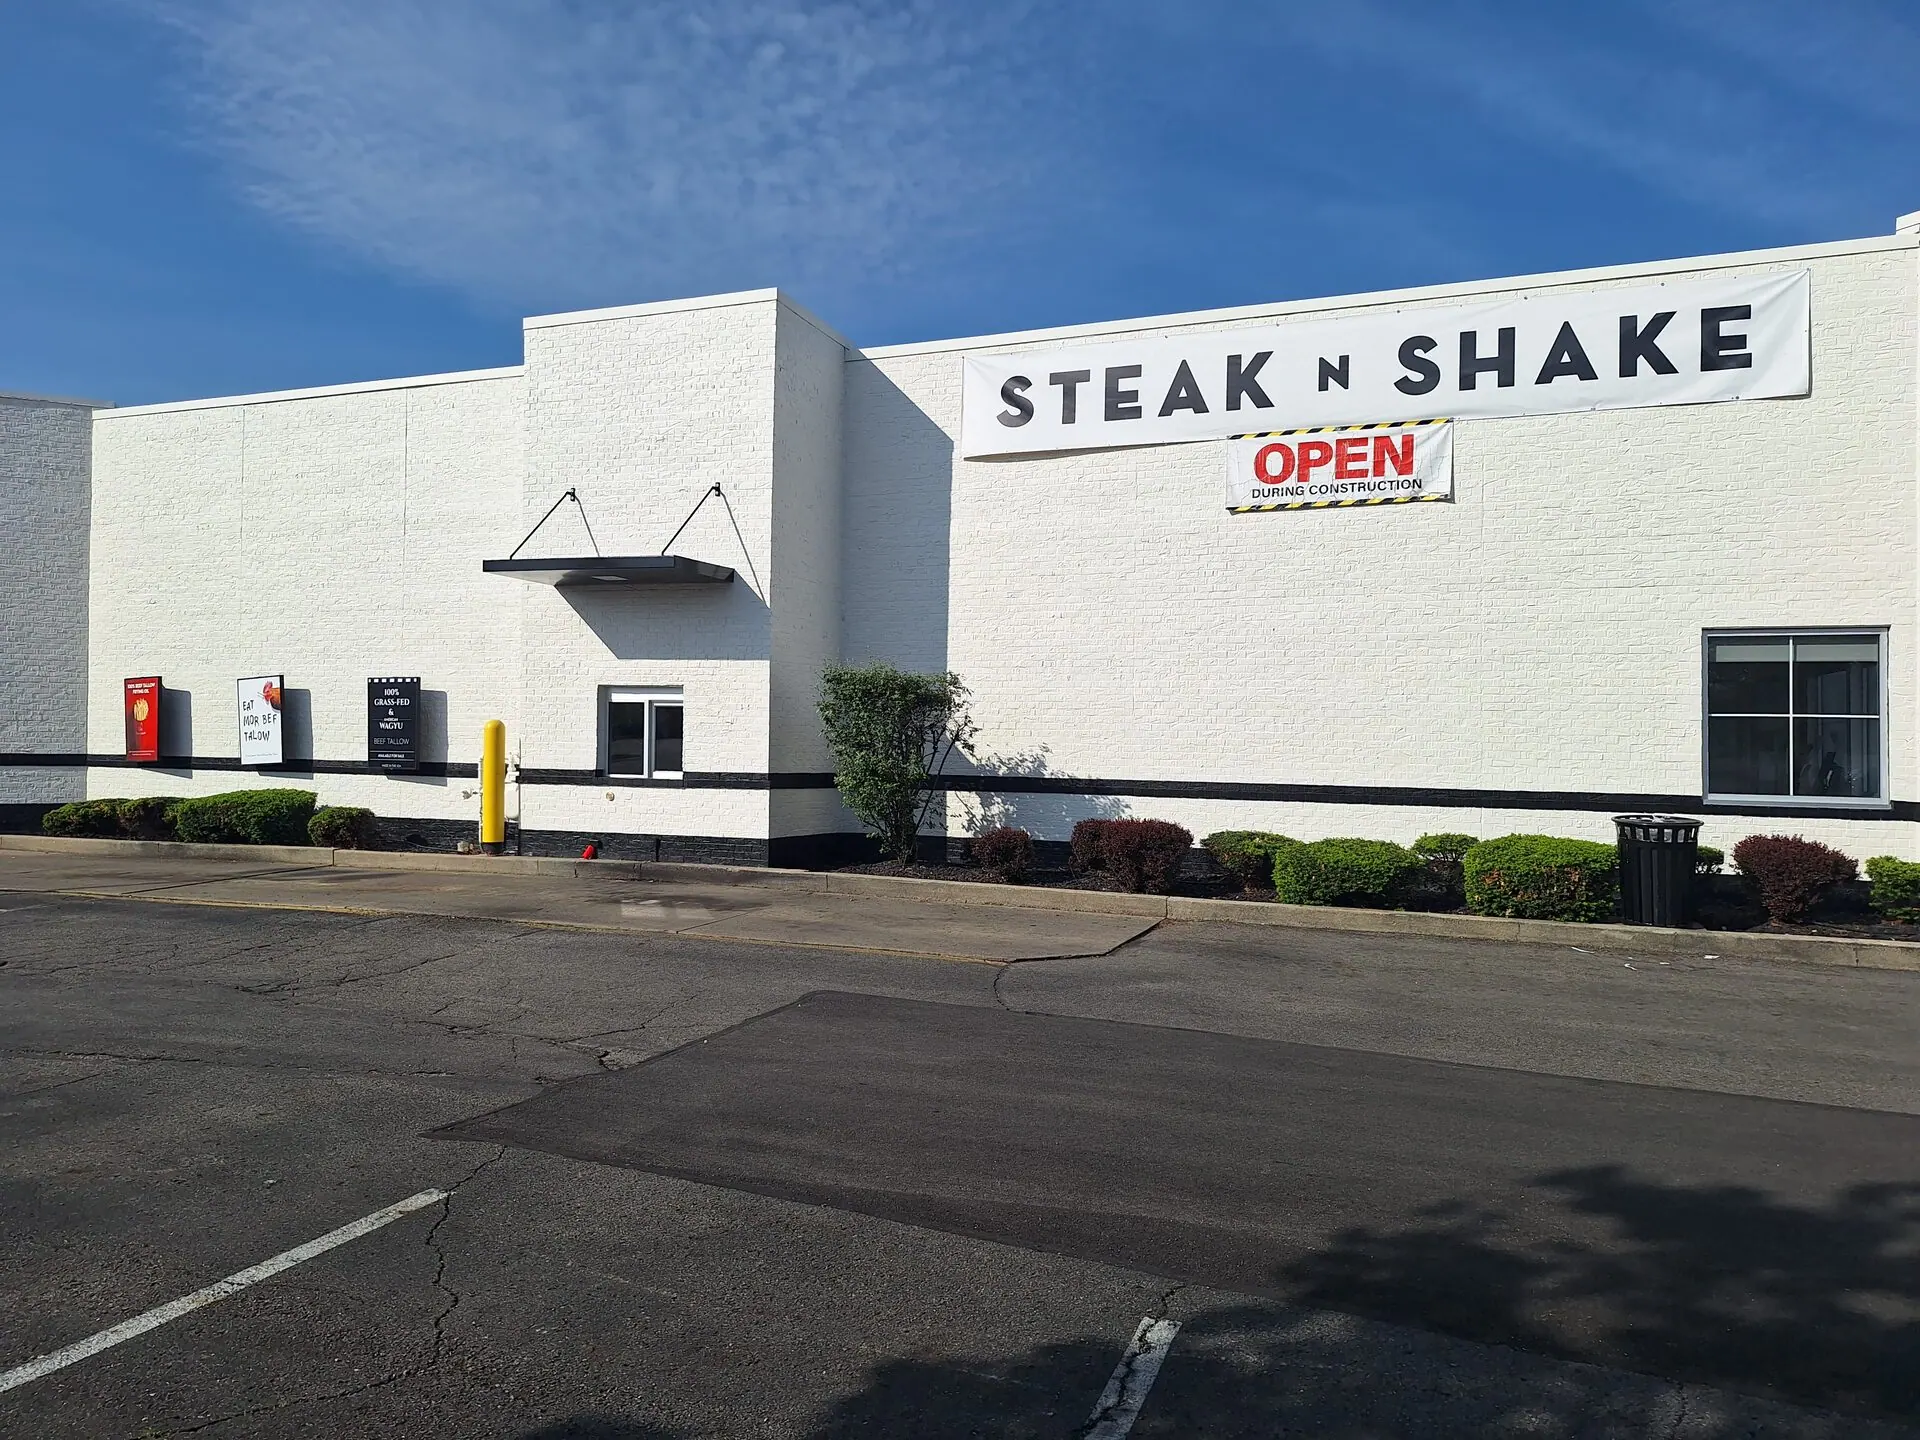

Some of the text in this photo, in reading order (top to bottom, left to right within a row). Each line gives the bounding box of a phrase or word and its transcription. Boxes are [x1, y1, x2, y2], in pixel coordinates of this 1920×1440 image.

[996, 304, 1752, 428] STEAK N SHAKE
[1253, 434, 1414, 484] OPEN
[1252, 478, 1422, 499] DURING CONSTRUCTION
[384, 688, 400, 696] 100%
[242, 700, 254, 711] EAT
[374, 698, 410, 706] GRASS-FED
[388, 708, 394, 716] &
[243, 713, 277, 727] MOR BEF
[379, 722, 403, 730] WAGYU
[244, 730, 270, 742] TALOW
[387, 737, 410, 745] TALLOW
